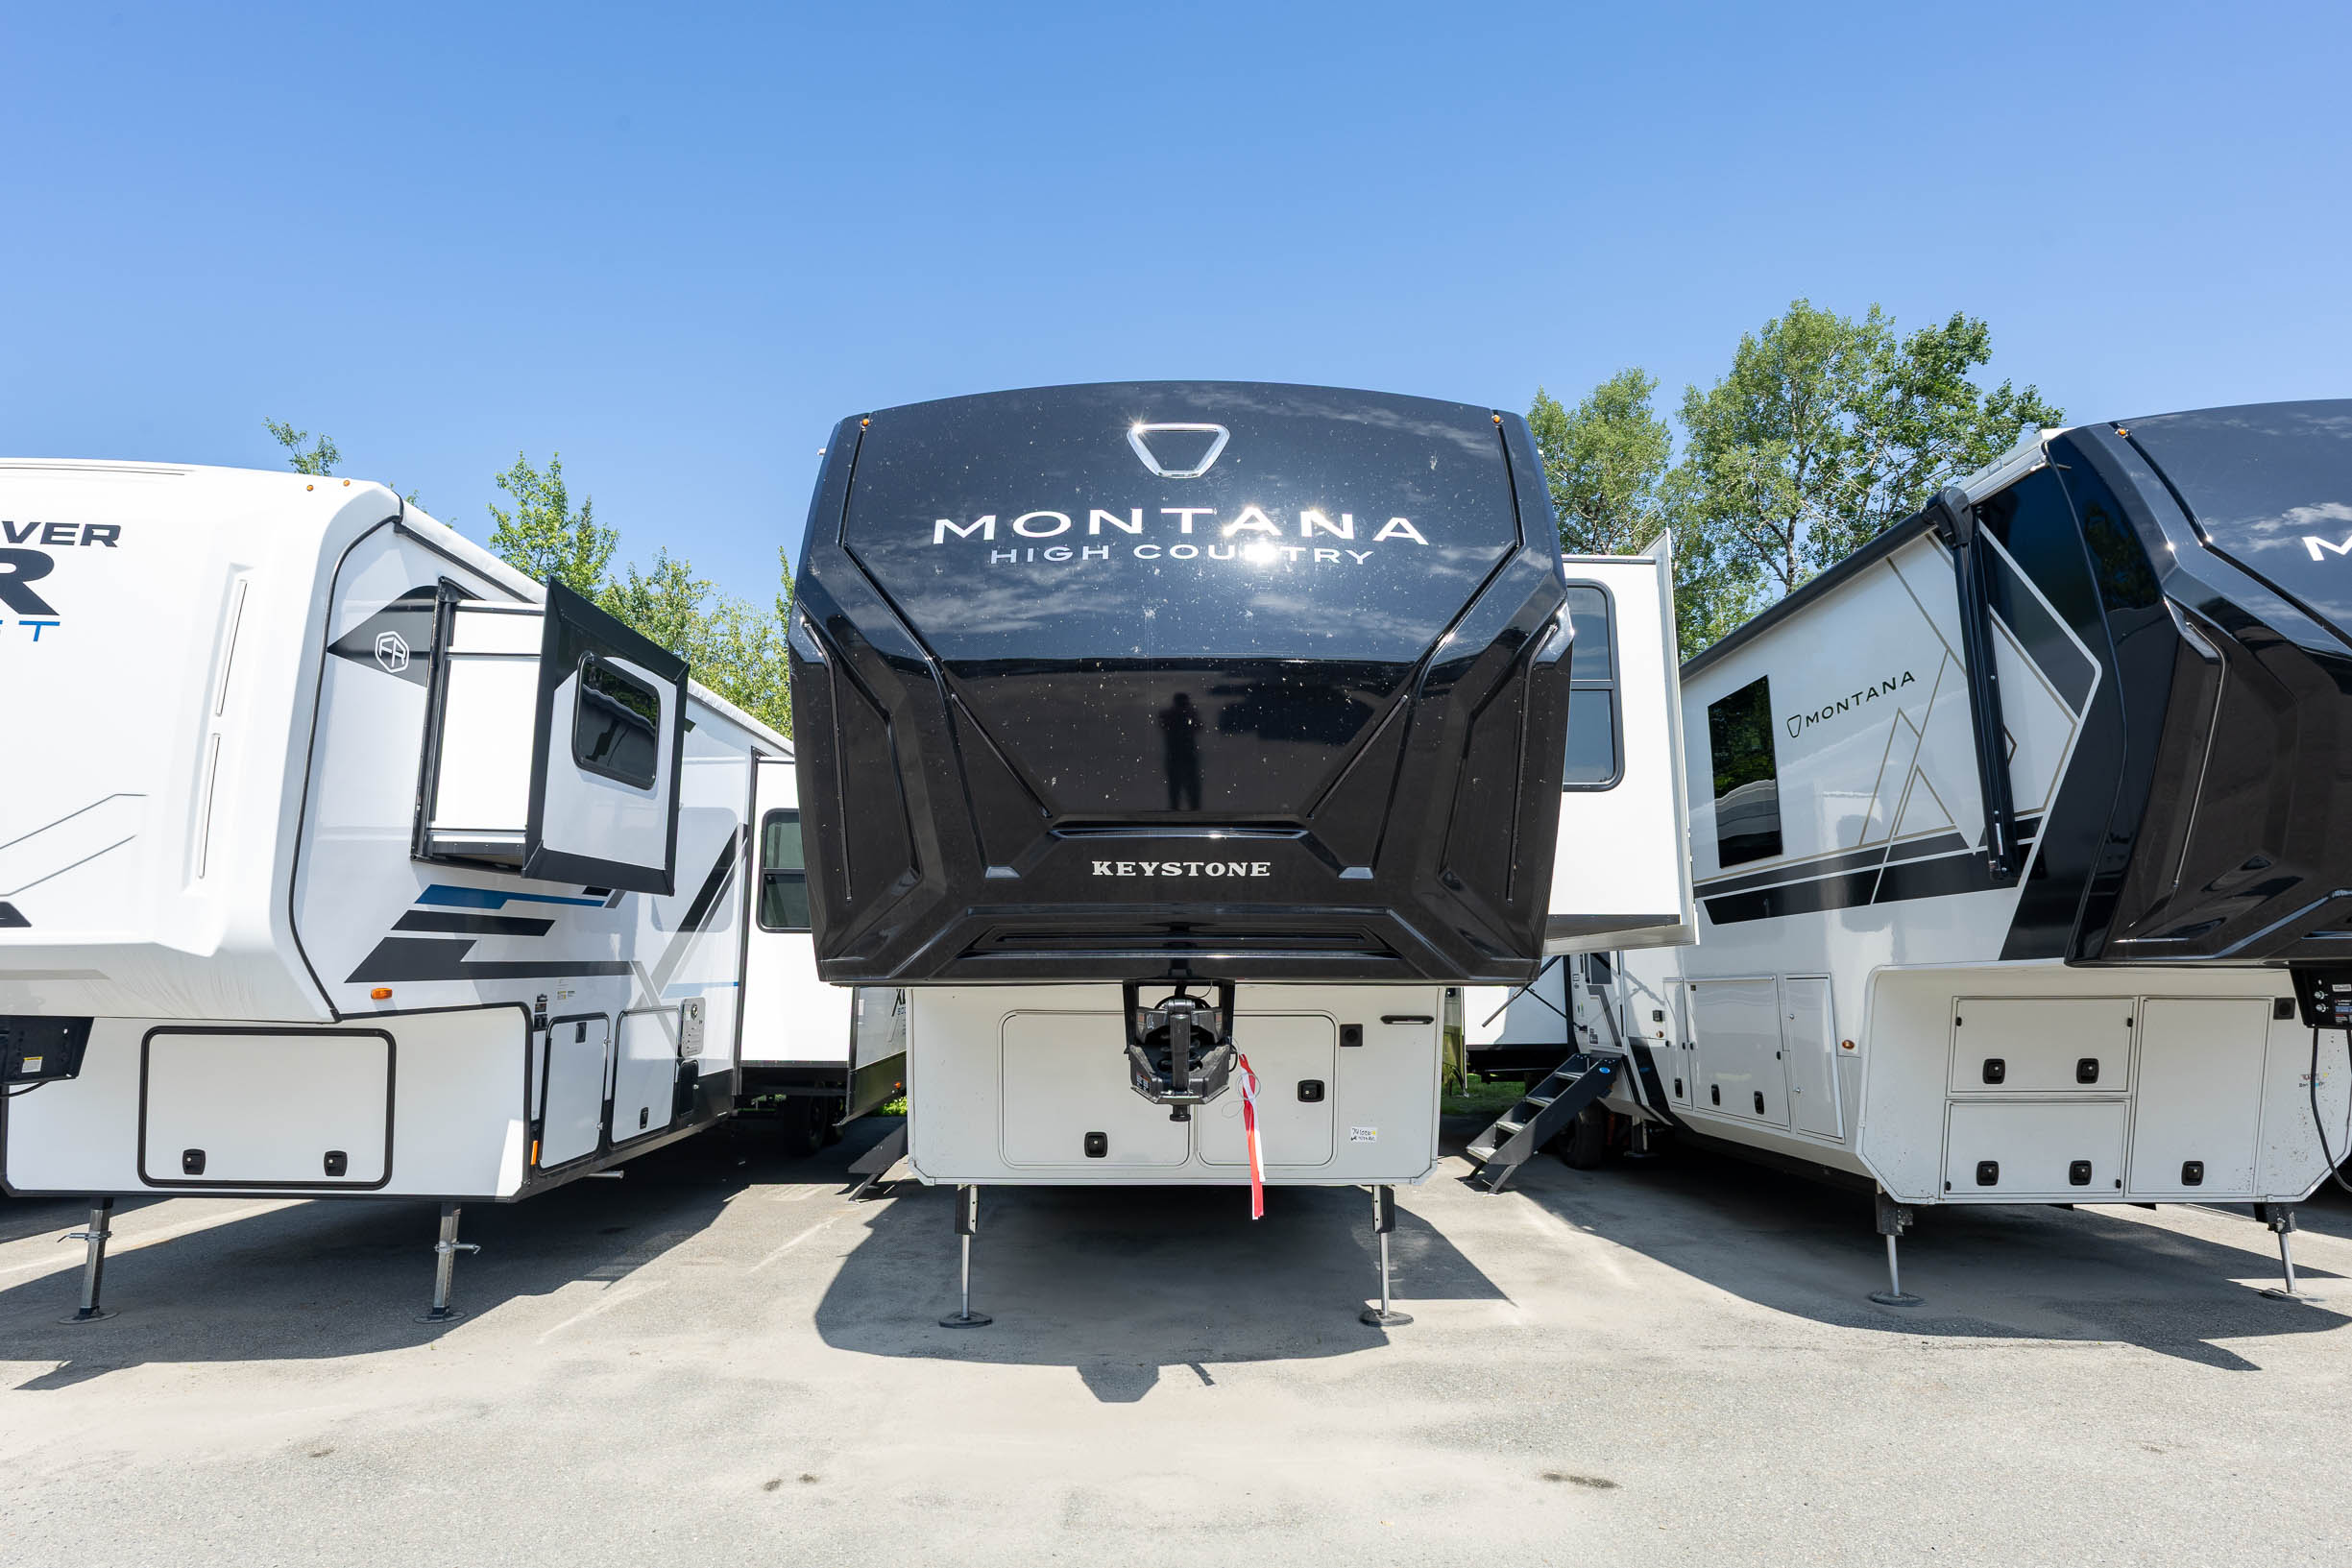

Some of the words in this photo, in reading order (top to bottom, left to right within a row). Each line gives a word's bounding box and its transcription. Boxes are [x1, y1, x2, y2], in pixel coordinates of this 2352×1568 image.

[1, 520, 121, 548] VER
[933, 508, 1429, 544] MONTANA
[990, 545, 1109, 565] HIGH
[1133, 543, 1373, 566] COUTRY
[1806, 670, 1916, 727] MONTANA
[1091, 860, 1271, 877] KEYSTONE
